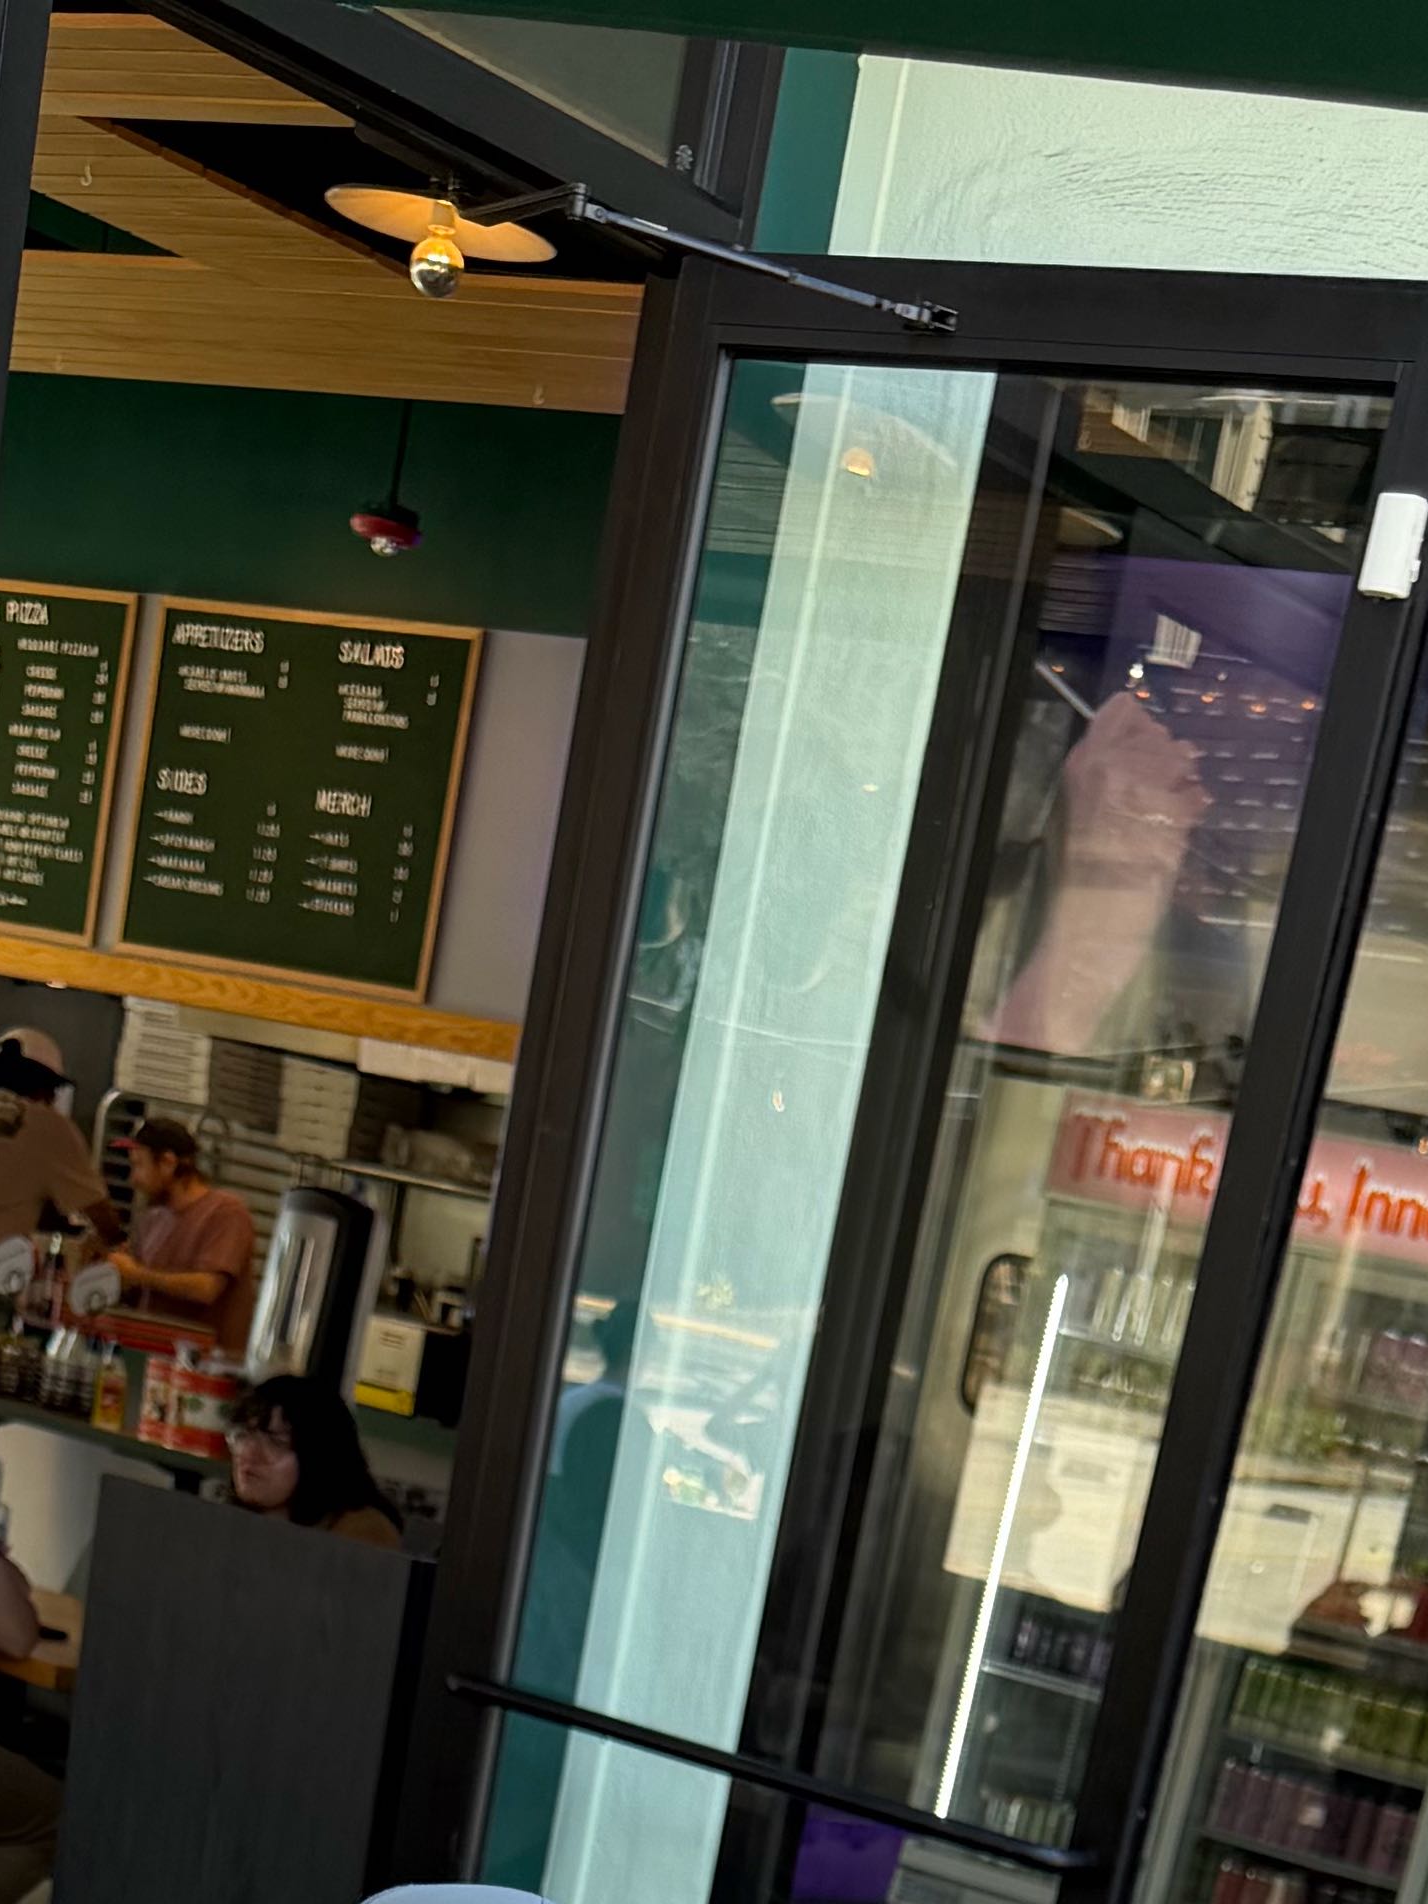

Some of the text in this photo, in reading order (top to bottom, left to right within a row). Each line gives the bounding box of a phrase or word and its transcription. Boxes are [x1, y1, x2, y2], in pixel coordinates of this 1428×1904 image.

[338, 640, 405, 670] SALADS
[156, 767, 208, 797] SIDES
[314, 787, 372, 819] MERCH
[1070, 1110, 1215, 1197] Thank
